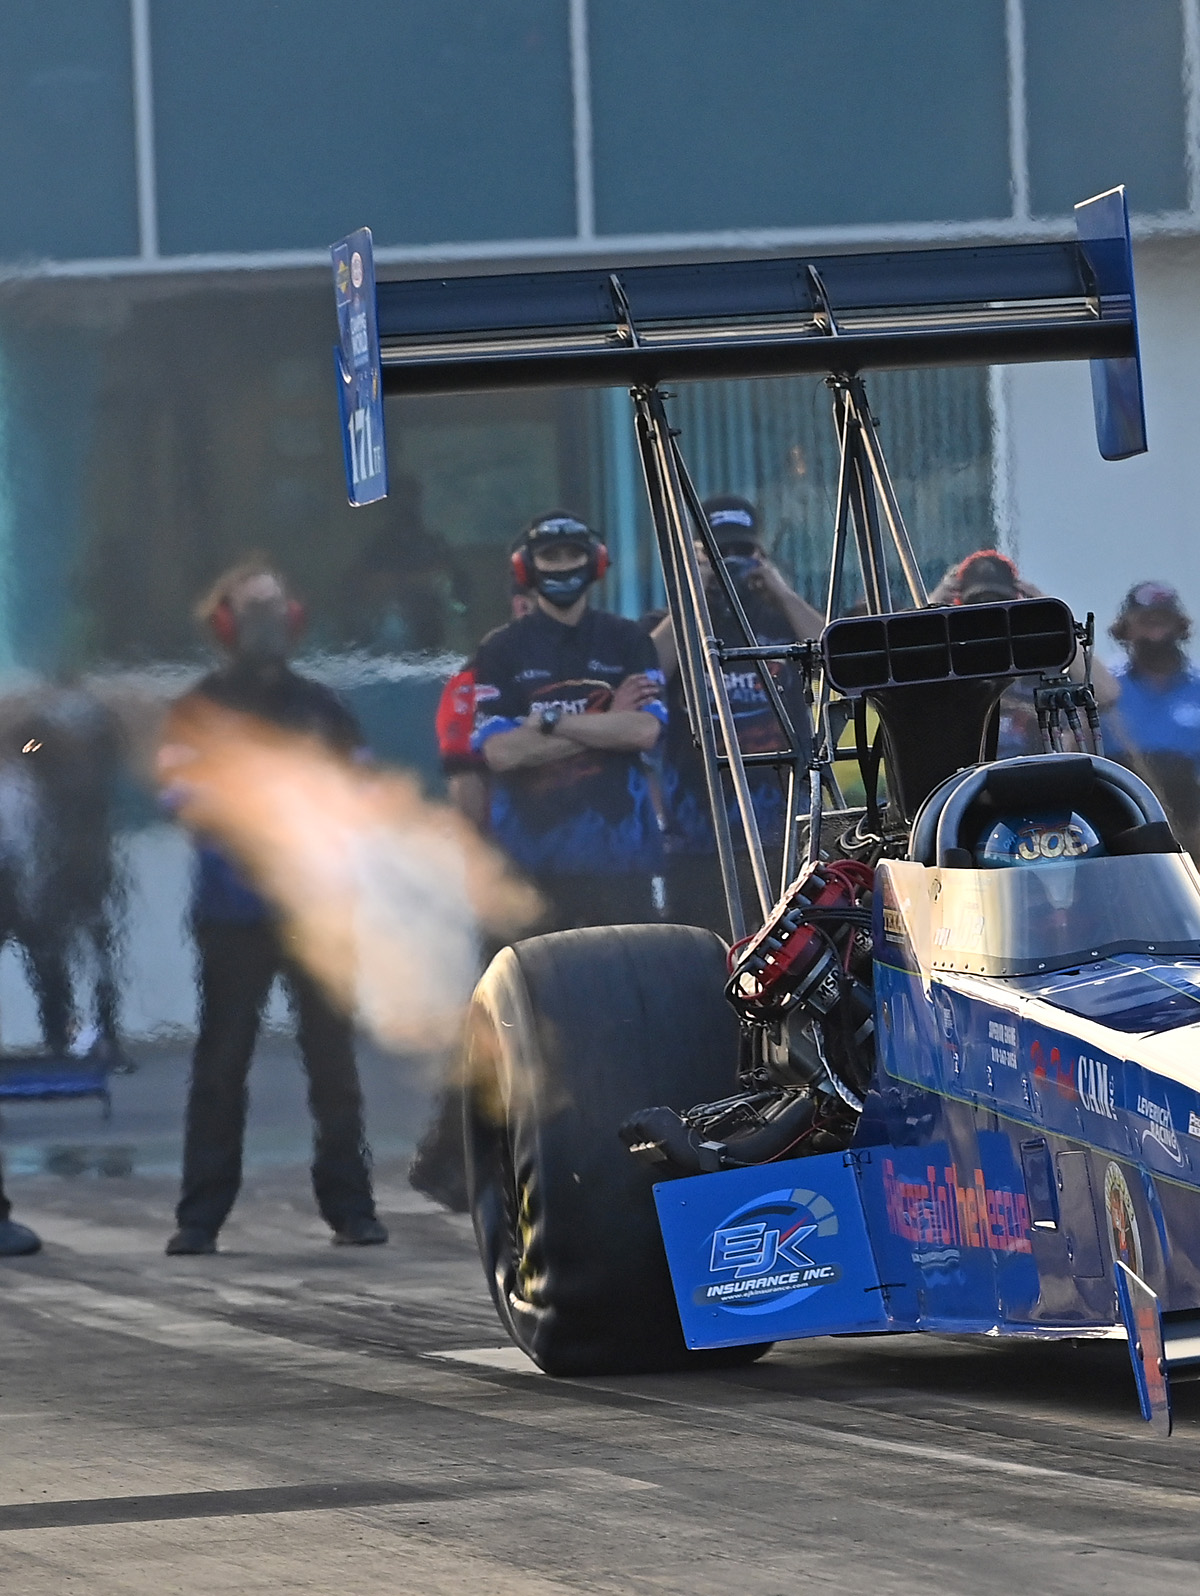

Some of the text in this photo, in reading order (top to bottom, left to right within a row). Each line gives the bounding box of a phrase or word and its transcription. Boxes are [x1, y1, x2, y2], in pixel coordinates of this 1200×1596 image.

[348, 405, 375, 484] 171
[1018, 826, 1089, 860] JOE
[1137, 1094, 1170, 1128] LEVERICH
[1150, 1120, 1178, 1150] RACING
[709, 1222, 818, 1279] EJK
[707, 1266, 835, 1297] INSURANCE INC.
[720, 1282, 809, 1301] www.ejkinsurance.com
